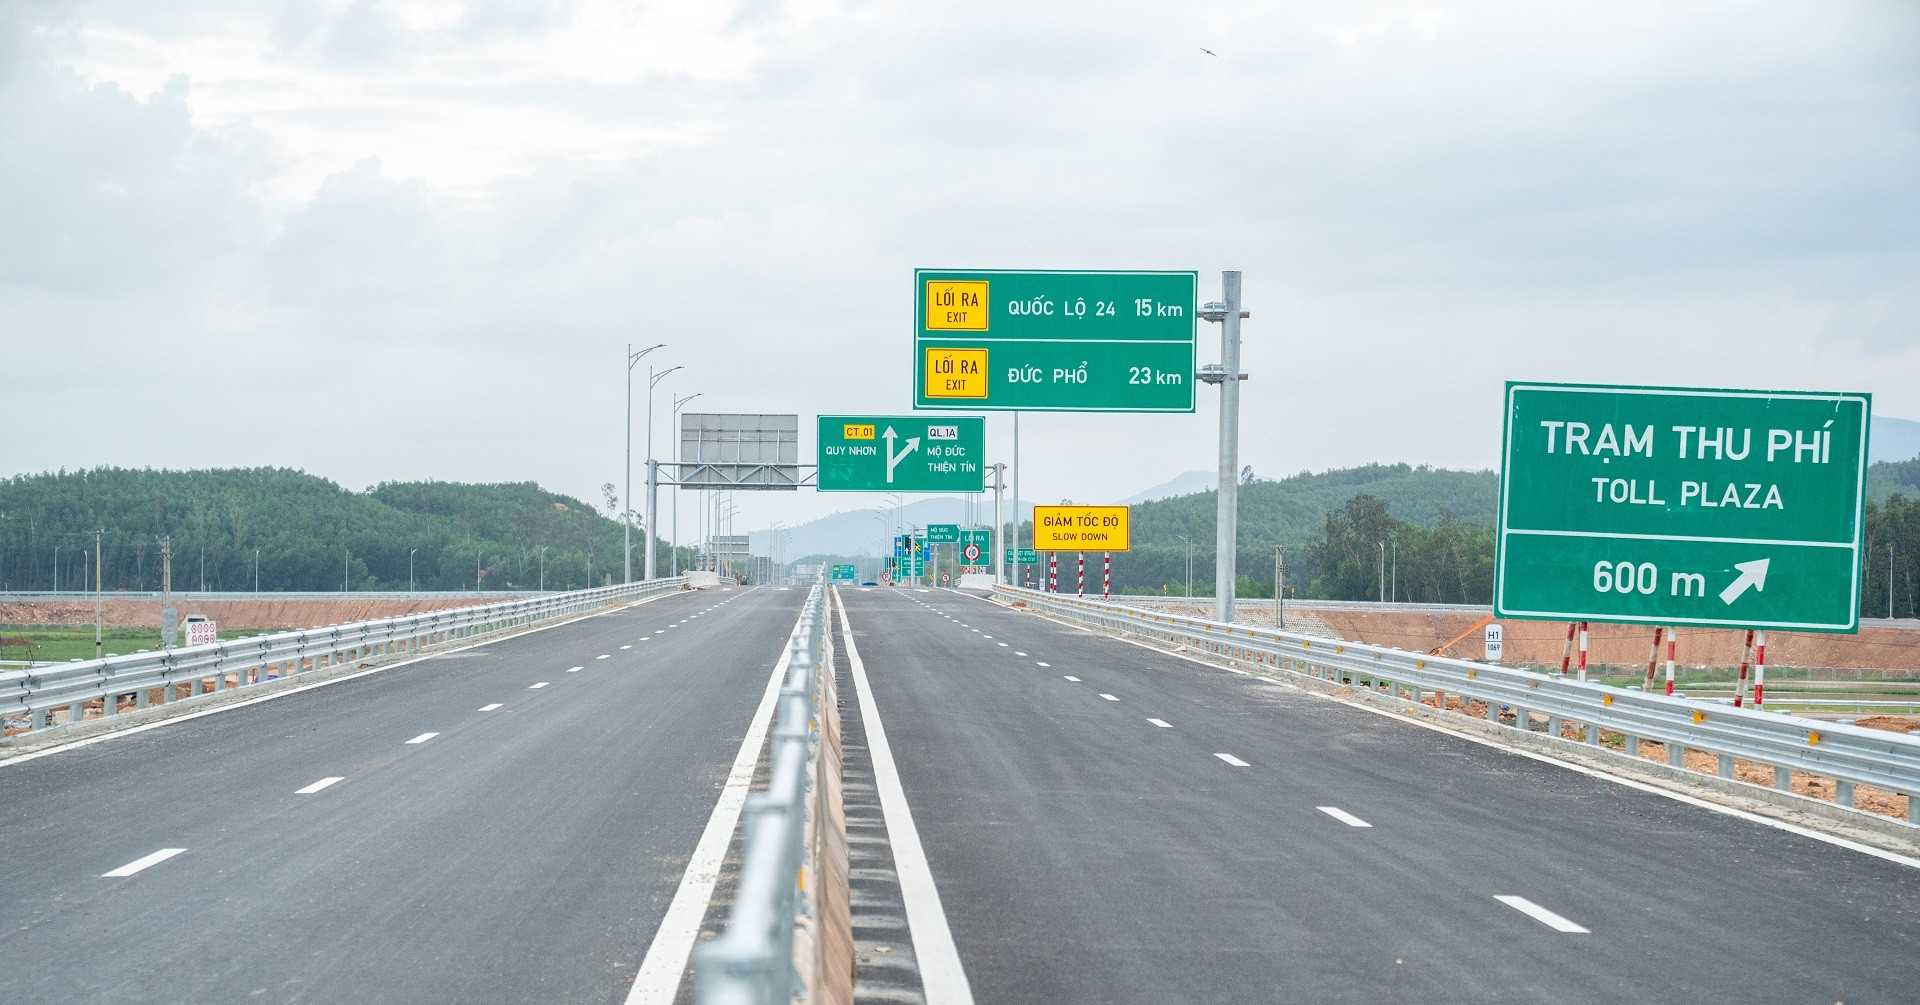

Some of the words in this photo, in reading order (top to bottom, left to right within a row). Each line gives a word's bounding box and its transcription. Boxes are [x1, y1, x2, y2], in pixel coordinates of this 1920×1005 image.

[936, 286, 955, 306] LỐI
[961, 292, 979, 306] RA
[1008, 294, 1054, 315] QUỐC
[1064, 296, 1086, 319] LỘ
[1095, 301, 1116, 316] 24
[1134, 298, 1152, 316] 15
[1157, 302, 1183, 317] km
[946, 311, 967, 323] EXIT
[935, 354, 954, 374] LỐI
[961, 360, 978, 374] RA
[1007, 363, 1043, 383] ĐỨC
[1053, 360, 1088, 384] PHỔ
[946, 379, 967, 391] EXIT
[1129, 366, 1152, 385] 23
[1156, 369, 1182, 385] km
[846, 427, 873, 437] CT.01
[929, 428, 956, 438] QL.1A
[825, 446, 846, 456] QUY
[848, 445, 877, 456] NHƠN
[1540, 420, 1654, 464] TRẠM
[1672, 425, 1751, 461] THU
[1767, 420, 1834, 464] PHÍ
[927, 445, 942, 459] MỘ
[944, 445, 966, 457] ĐỨC
[928, 460, 957, 474] THIỆN
[960, 460, 976, 473] TÍN
[1591, 477, 1666, 506] TOLL
[1680, 481, 1784, 510] PLAZA
[1043, 512, 1073, 527] GIẢM
[1077, 511, 1099, 527] TỐC
[1102, 513, 1119, 530] ĐỘ
[1052, 532, 1078, 541] SLOW
[1081, 532, 1108, 541] DOWN
[1593, 560, 1658, 595] 600
[1670, 572, 1705, 597] m
[1488, 631, 1499, 640] H1
